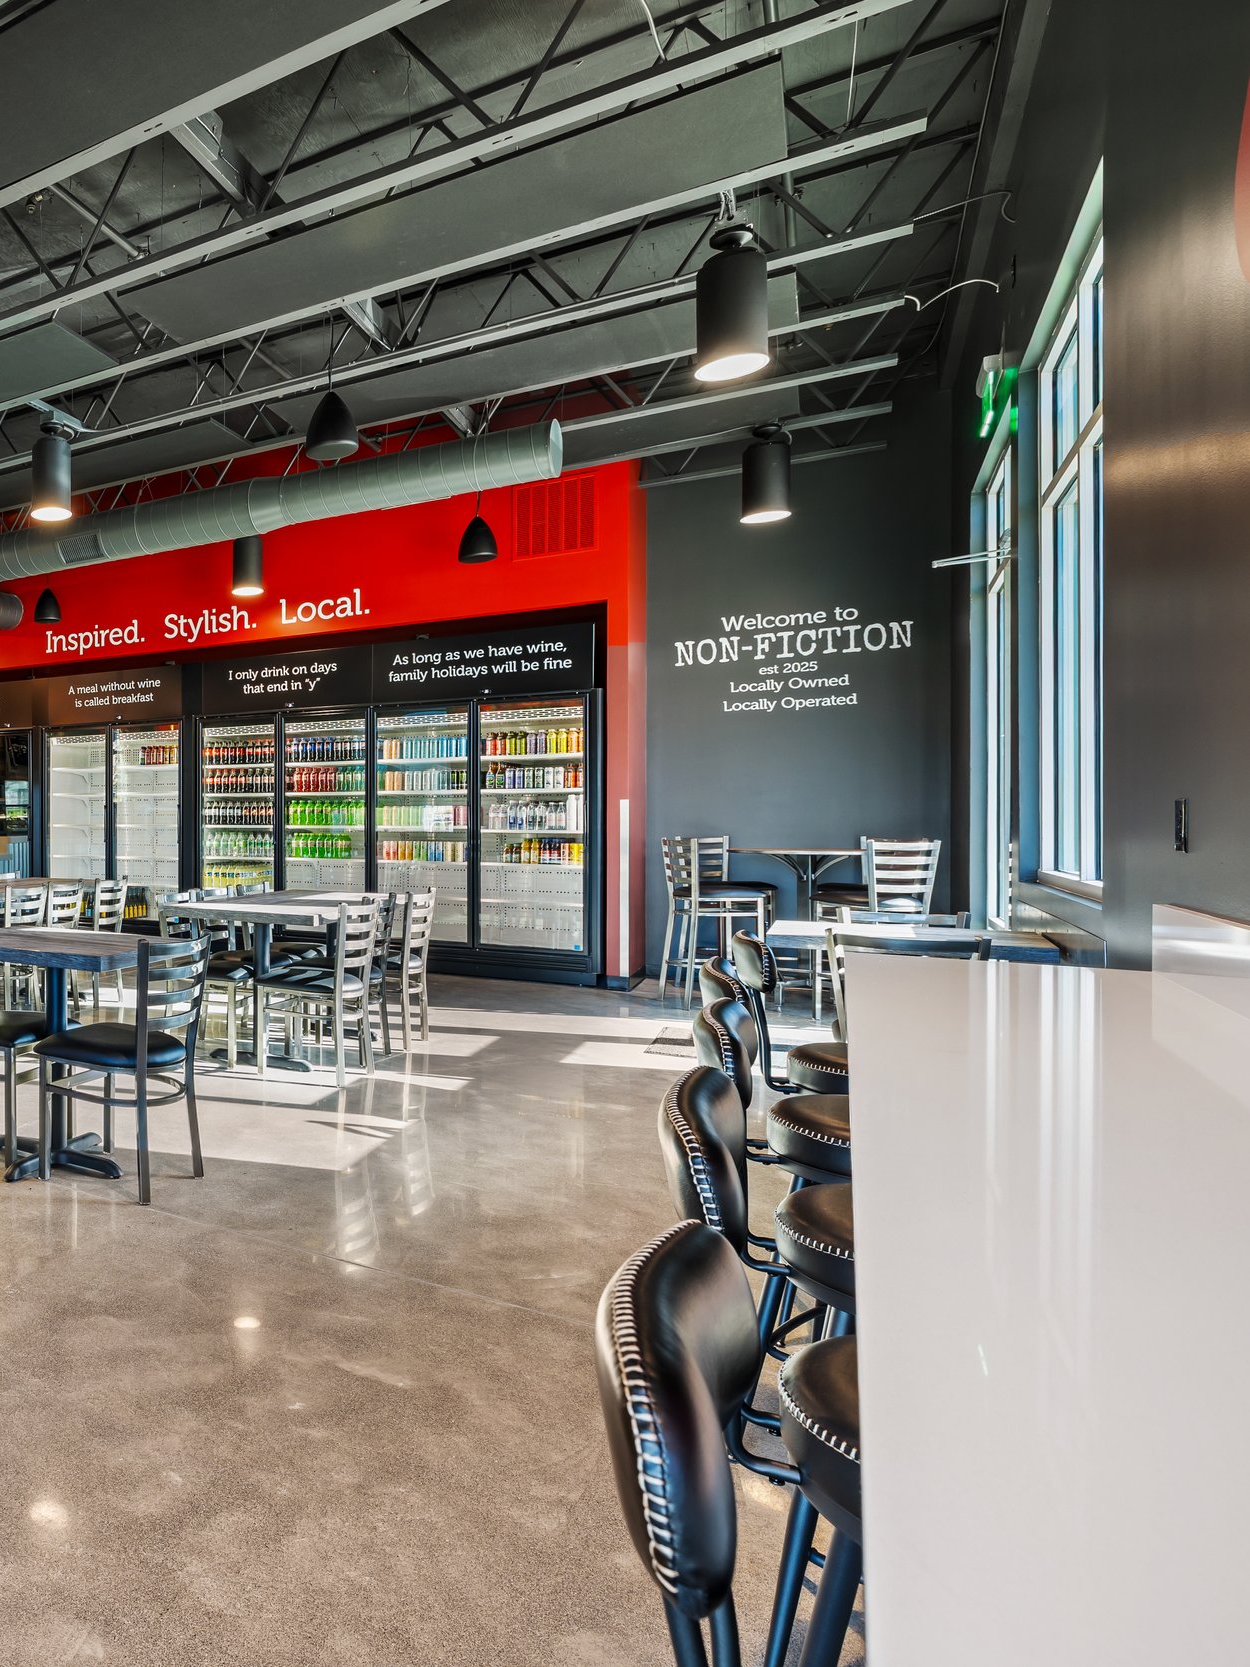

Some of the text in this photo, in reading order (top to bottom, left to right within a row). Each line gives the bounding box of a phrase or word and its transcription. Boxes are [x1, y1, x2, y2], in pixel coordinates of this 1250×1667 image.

[45, 588, 371, 655] Inspired. Stylish. Local.
[720, 606, 859, 632] Welcome to
[392, 639, 568, 667] As long as we have wine,
[674, 620, 914, 667] NON-FICTION
[228, 660, 338, 683] I only drink on days
[388, 656, 573, 684] family holidays will be fine
[758, 660, 818, 675] est 2025
[67, 678, 161, 695] A meal without wine
[242, 682, 266, 695] that
[267, 681, 289, 694] end
[290, 679, 303, 692] in
[729, 673, 850, 693] Locally Owned
[74, 692, 154, 708] is called breakfast
[722, 692, 858, 712] Locally Operated
